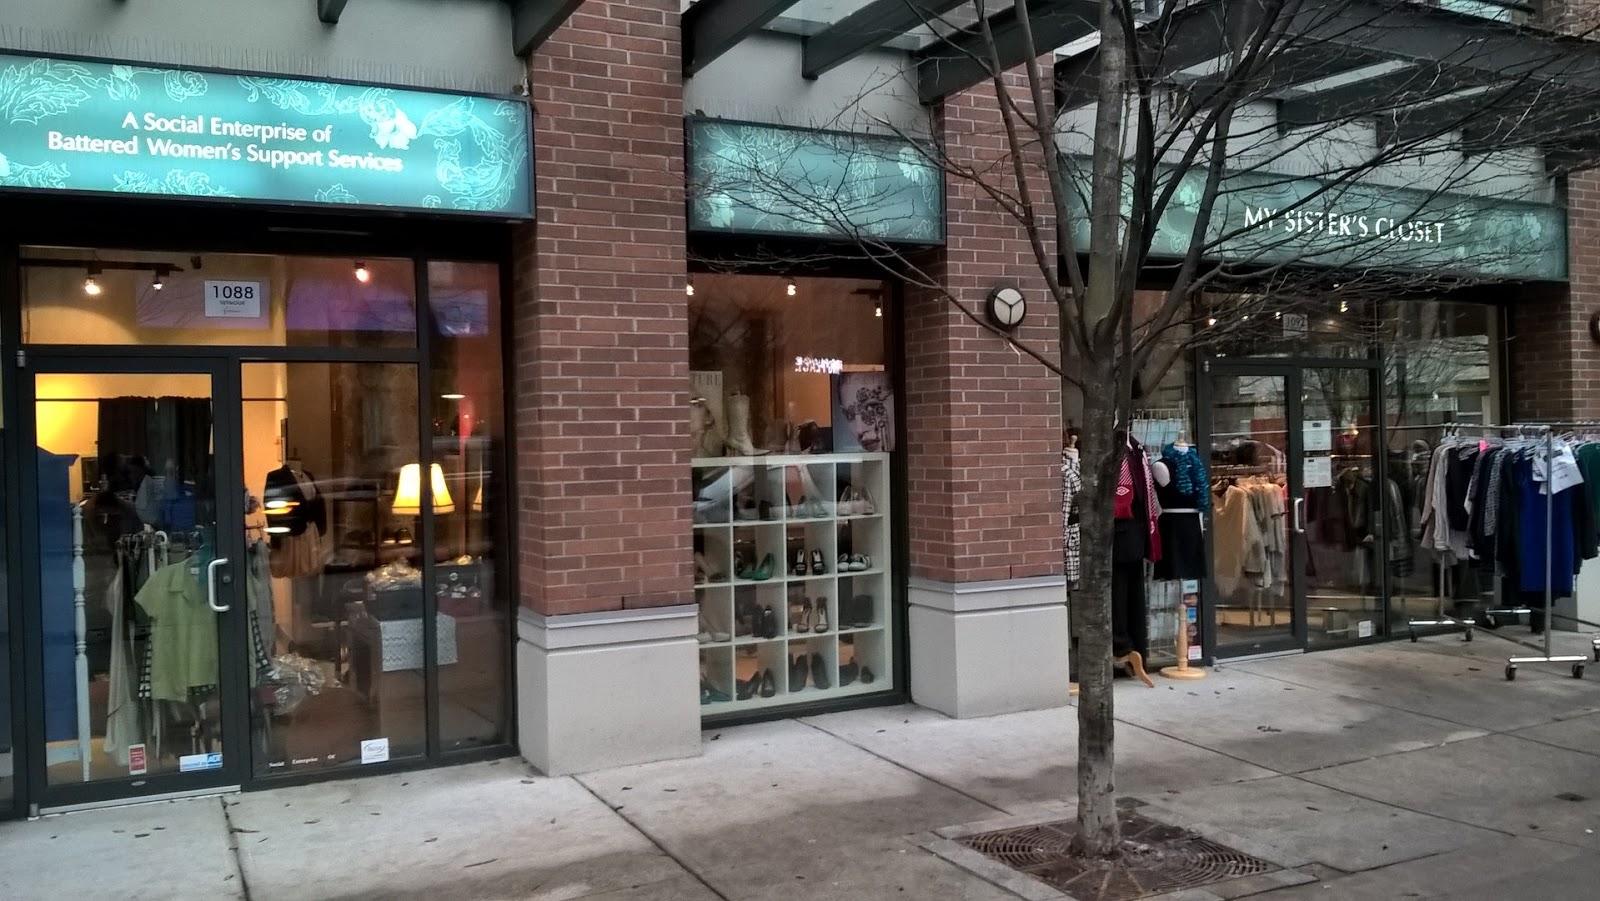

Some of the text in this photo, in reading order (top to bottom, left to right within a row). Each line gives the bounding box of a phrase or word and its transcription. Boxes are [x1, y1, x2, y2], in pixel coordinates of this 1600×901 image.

[121, 111, 334, 144] A Social Enterprise of
[48, 131, 404, 172] Battered Women's Support Services
[1244, 205, 1445, 243] MY SISTER'S CLOSET
[213, 285, 254, 299] 1088
